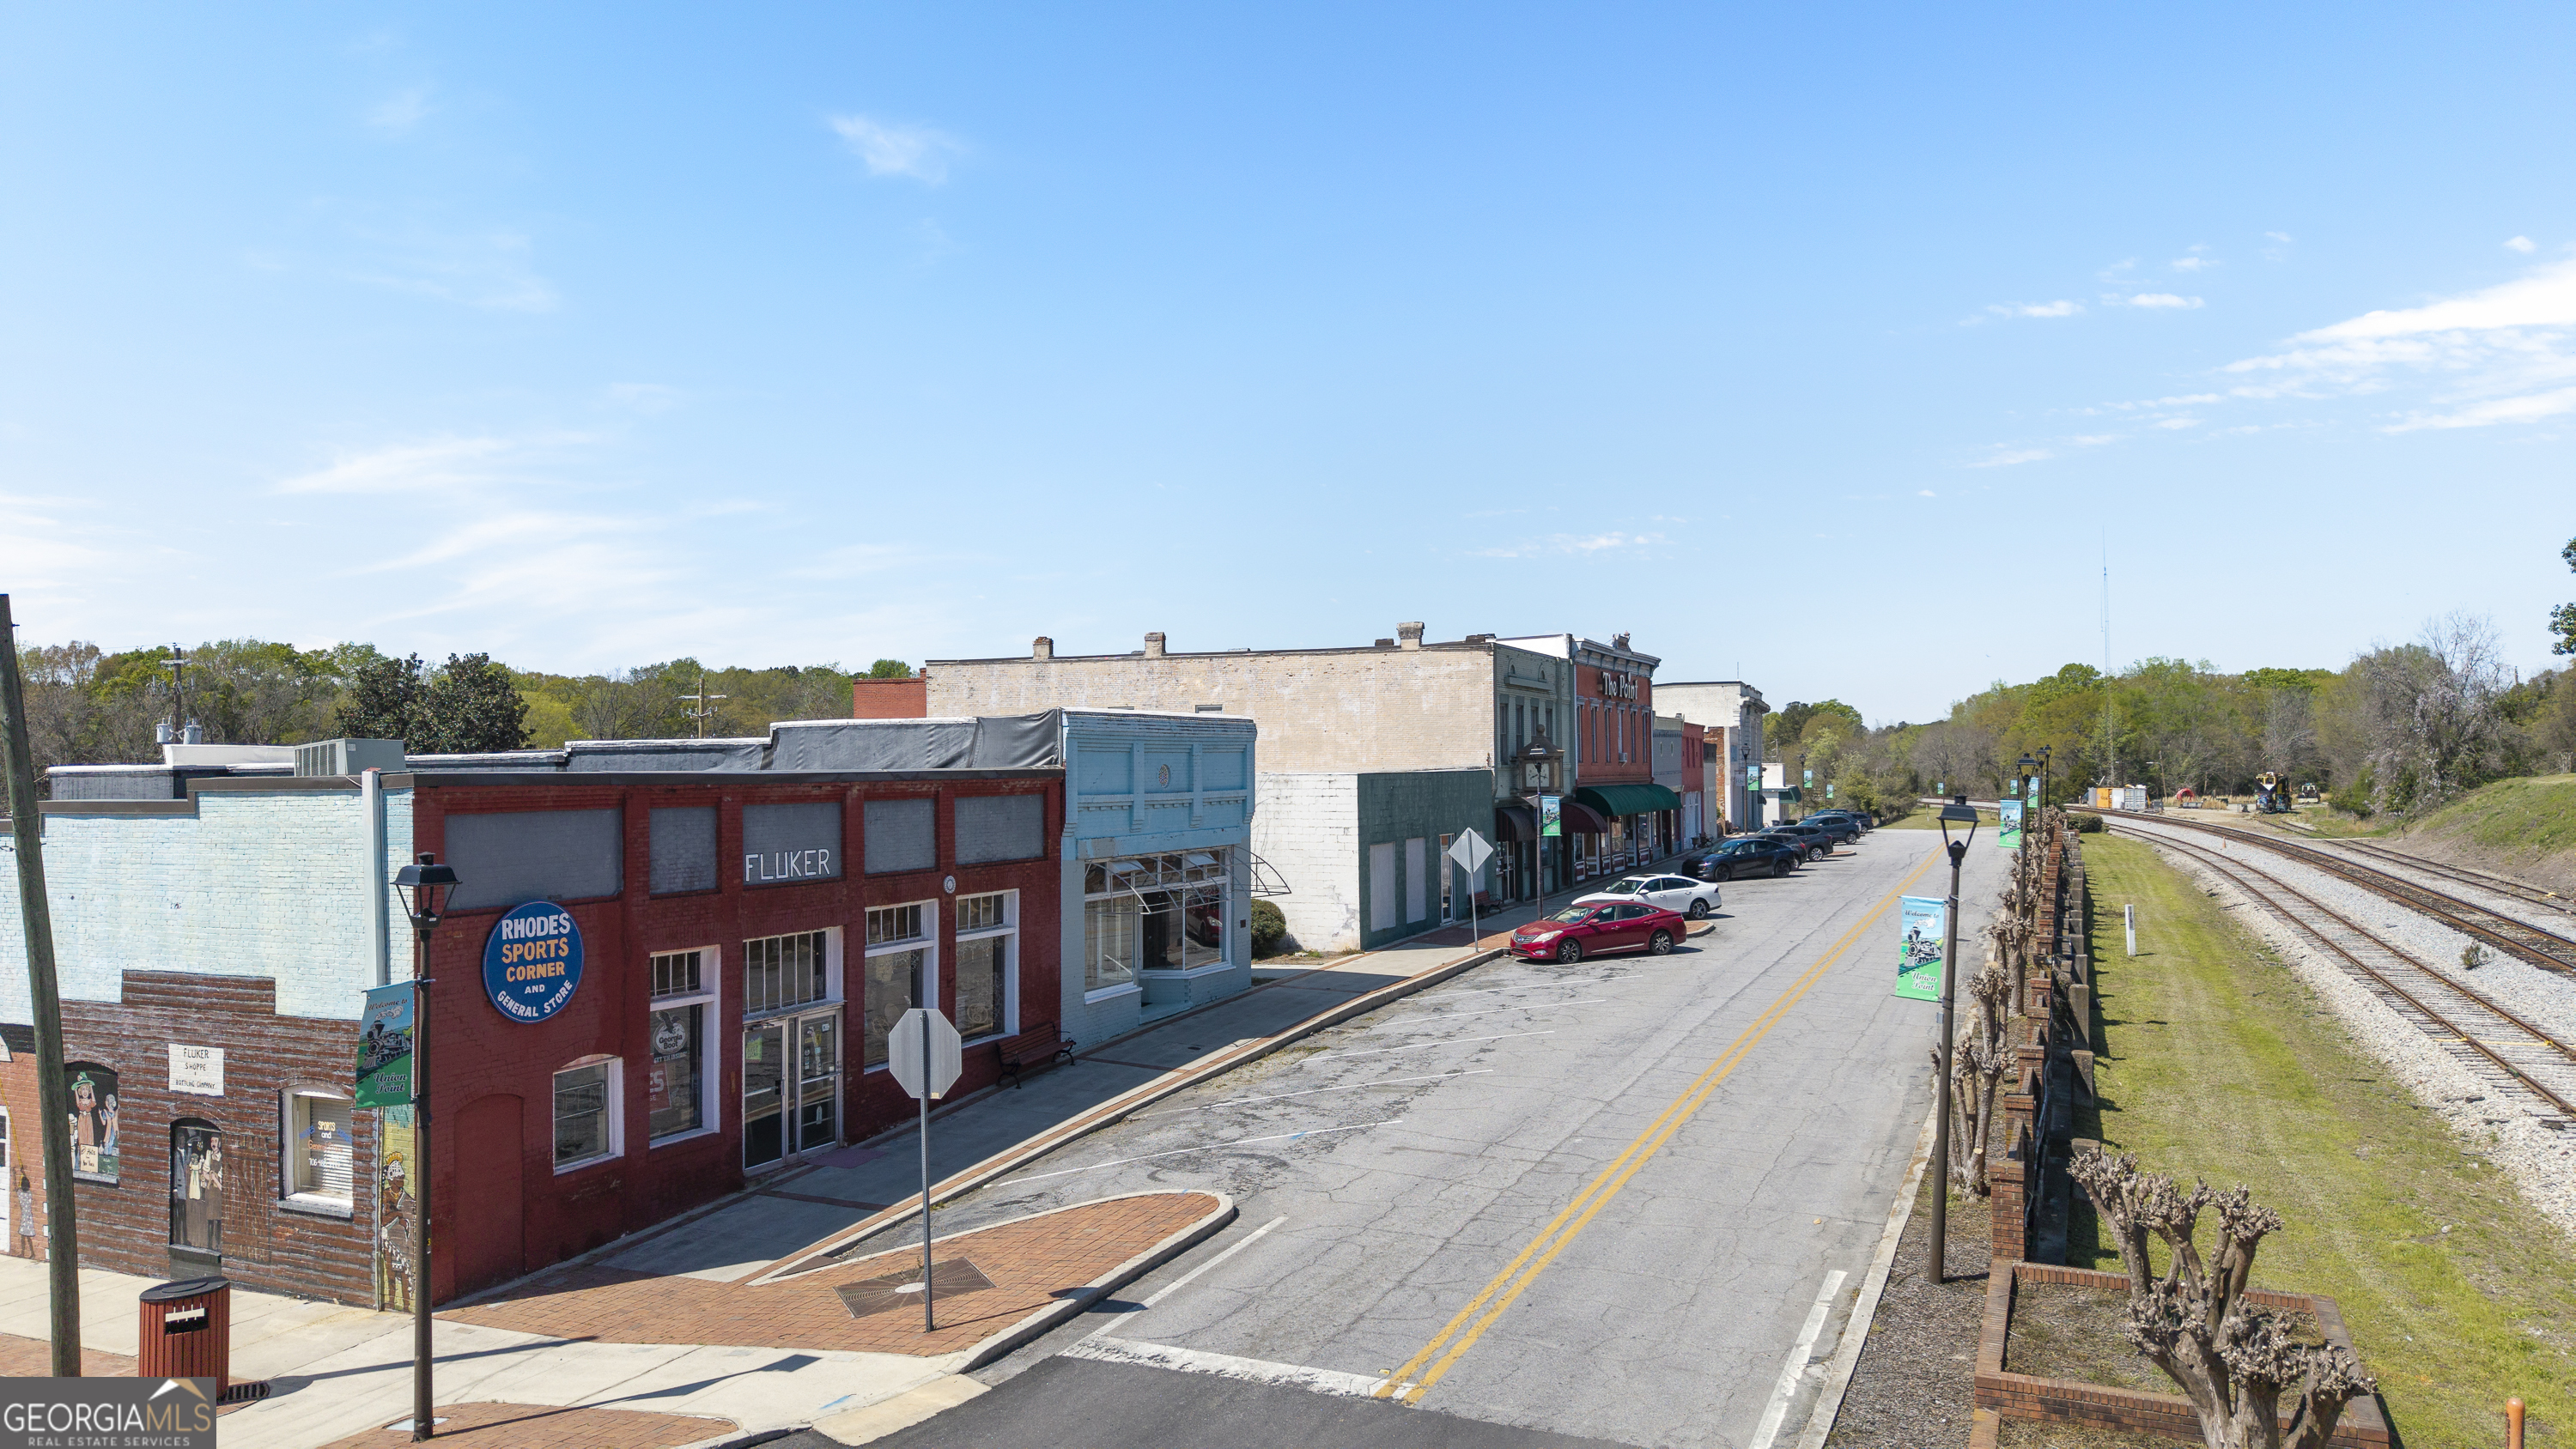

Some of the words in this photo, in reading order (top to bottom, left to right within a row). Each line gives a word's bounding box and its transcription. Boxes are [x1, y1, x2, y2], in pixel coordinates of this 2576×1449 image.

[1602, 671, 1617, 698] The
[1619, 671, 1638, 700] Point
[745, 849, 830, 882] FLUKER
[501, 912, 571, 940] RHODES
[501, 937, 569, 964] SPORTS
[506, 961, 566, 983] CORNER
[1911, 971, 1937, 983] Union
[524, 984, 545, 994] AND
[1911, 980, 1935, 991] Point
[368, 999, 400, 1011] Welcome
[401, 997, 409, 1006] to
[497, 990, 539, 1017] GENERAL
[543, 979, 574, 1014] STORE
[659, 1034, 683, 1045] Georgia
[663, 1040, 678, 1050] Boot
[183, 1047, 210, 1059] FLUKER
[185, 1062, 207, 1071] SHOPPE
[374, 1072, 407, 1083] Union
[375, 1082, 405, 1094] Point
[318, 1120, 336, 1132] SPORTS
